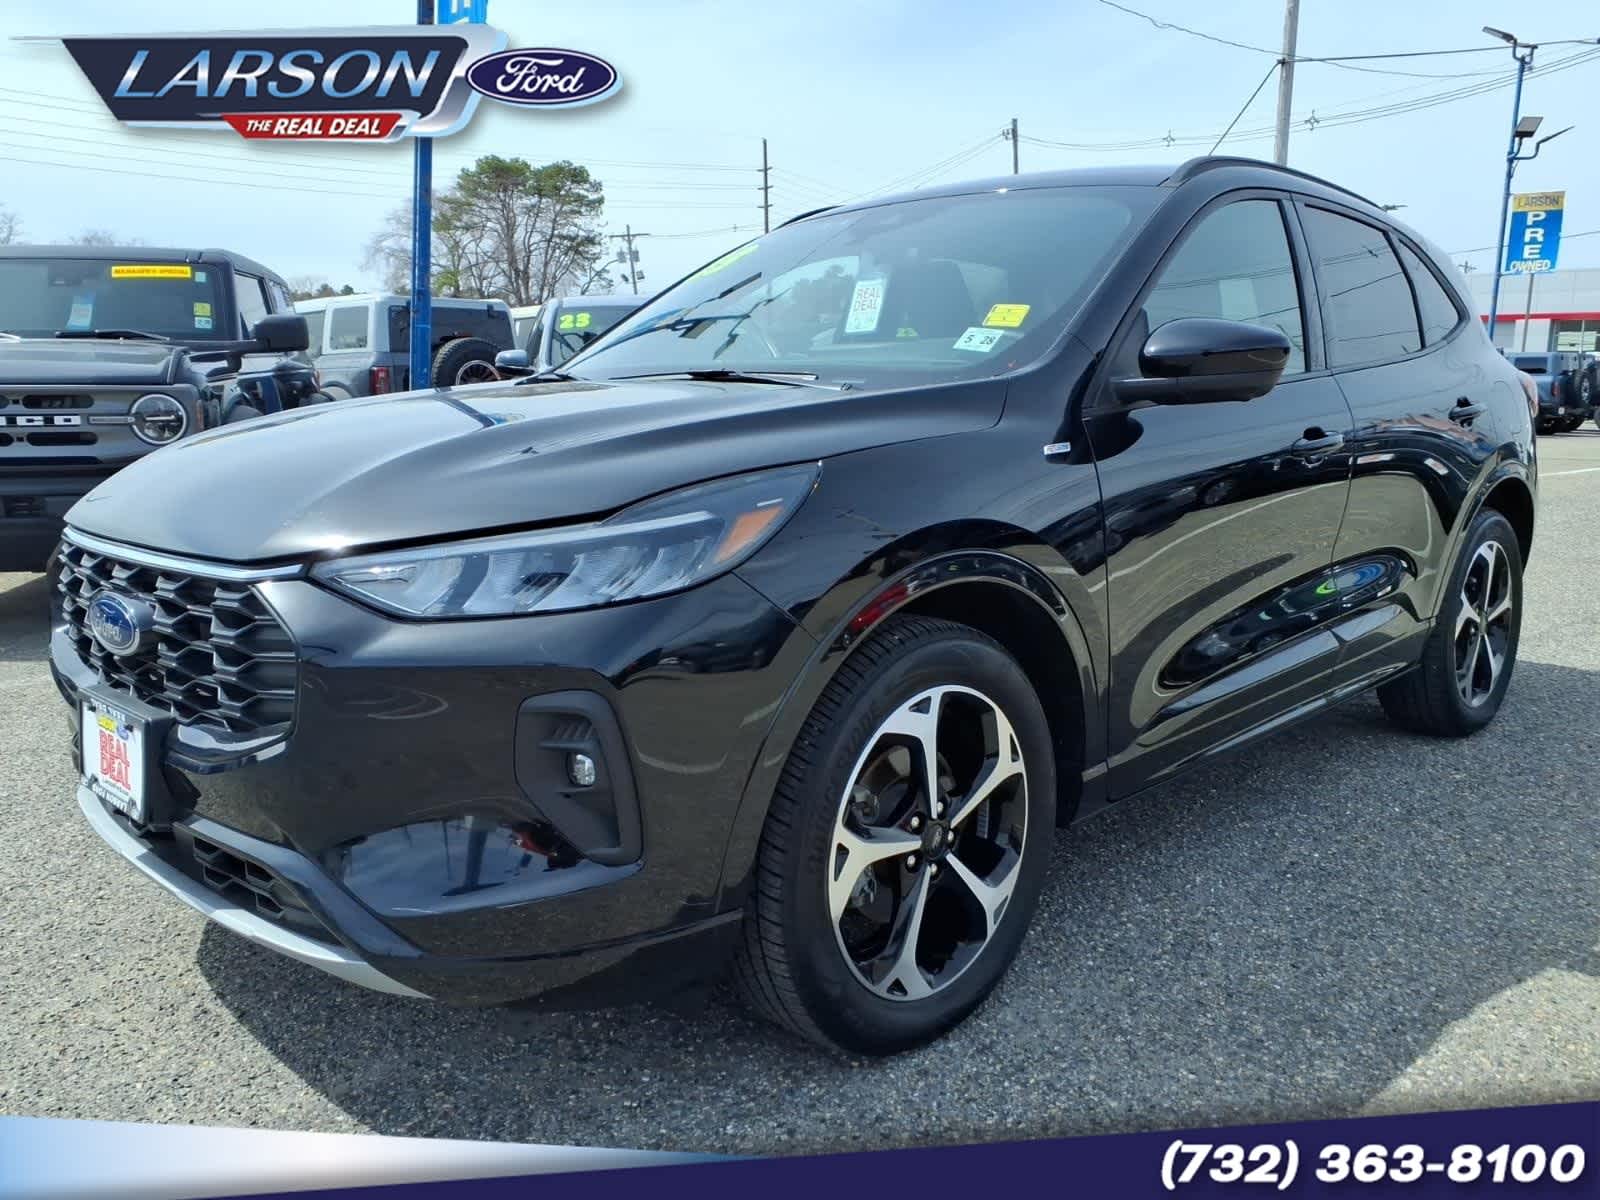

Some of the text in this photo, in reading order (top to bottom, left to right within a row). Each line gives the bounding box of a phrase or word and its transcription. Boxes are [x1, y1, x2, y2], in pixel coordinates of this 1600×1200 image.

[1517, 195, 1559, 208] LARSON
[1523, 211, 1547, 259] PRE
[1511, 260, 1551, 272] OWNED
[559, 313, 591, 329] 23
[0, 416, 81, 426] CO
[99, 729, 130, 767] REAL
[99, 753, 131, 791] DEAL
